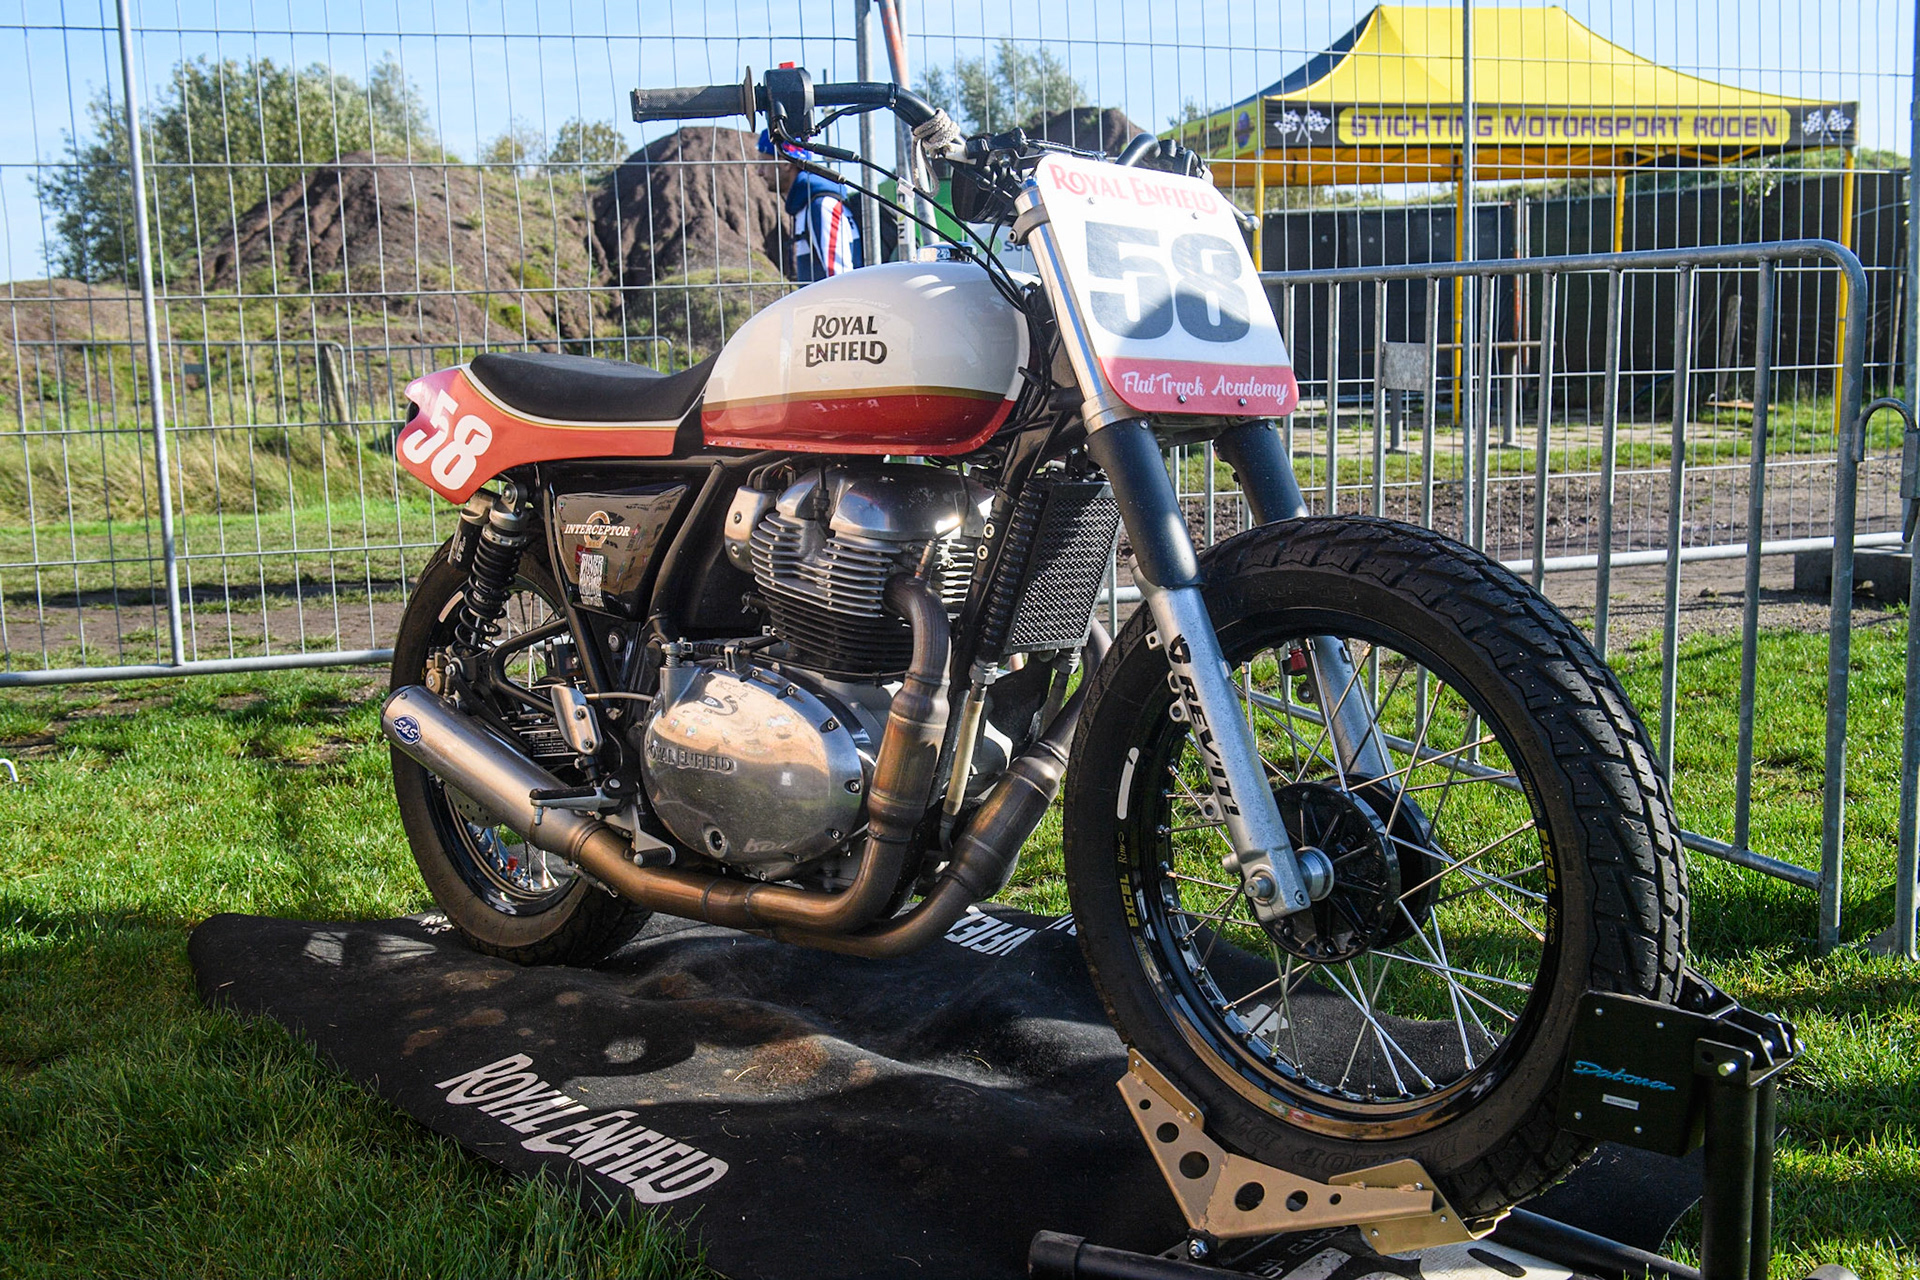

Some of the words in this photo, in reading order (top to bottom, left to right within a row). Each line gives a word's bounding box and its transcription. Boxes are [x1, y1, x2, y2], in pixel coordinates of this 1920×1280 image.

[1504, 115, 1682, 138] MOTORSPORT
[1693, 116, 1777, 138] RODEN
[1047, 163, 1130, 201] ROYAL
[1129, 176, 1218, 215] ENFIELD
[1084, 220, 1251, 343] 58
[811, 314, 878, 339] ROYAL
[805, 339, 888, 368] ENFIELD
[1121, 370, 1157, 395] Flat
[1157, 372, 1205, 399] Track
[1210, 374, 1289, 406] Academy
[402, 388, 493, 491] 58
[563, 523, 631, 537] INTERCEPTOR
[394, 719, 419, 739] S&S
[1538, 827, 1558, 894] EXCEL
[1119, 873, 1140, 928] EXCEL
[434, 1052, 589, 1134] ROYAL
[520, 1109, 730, 1204] ENFIELD
